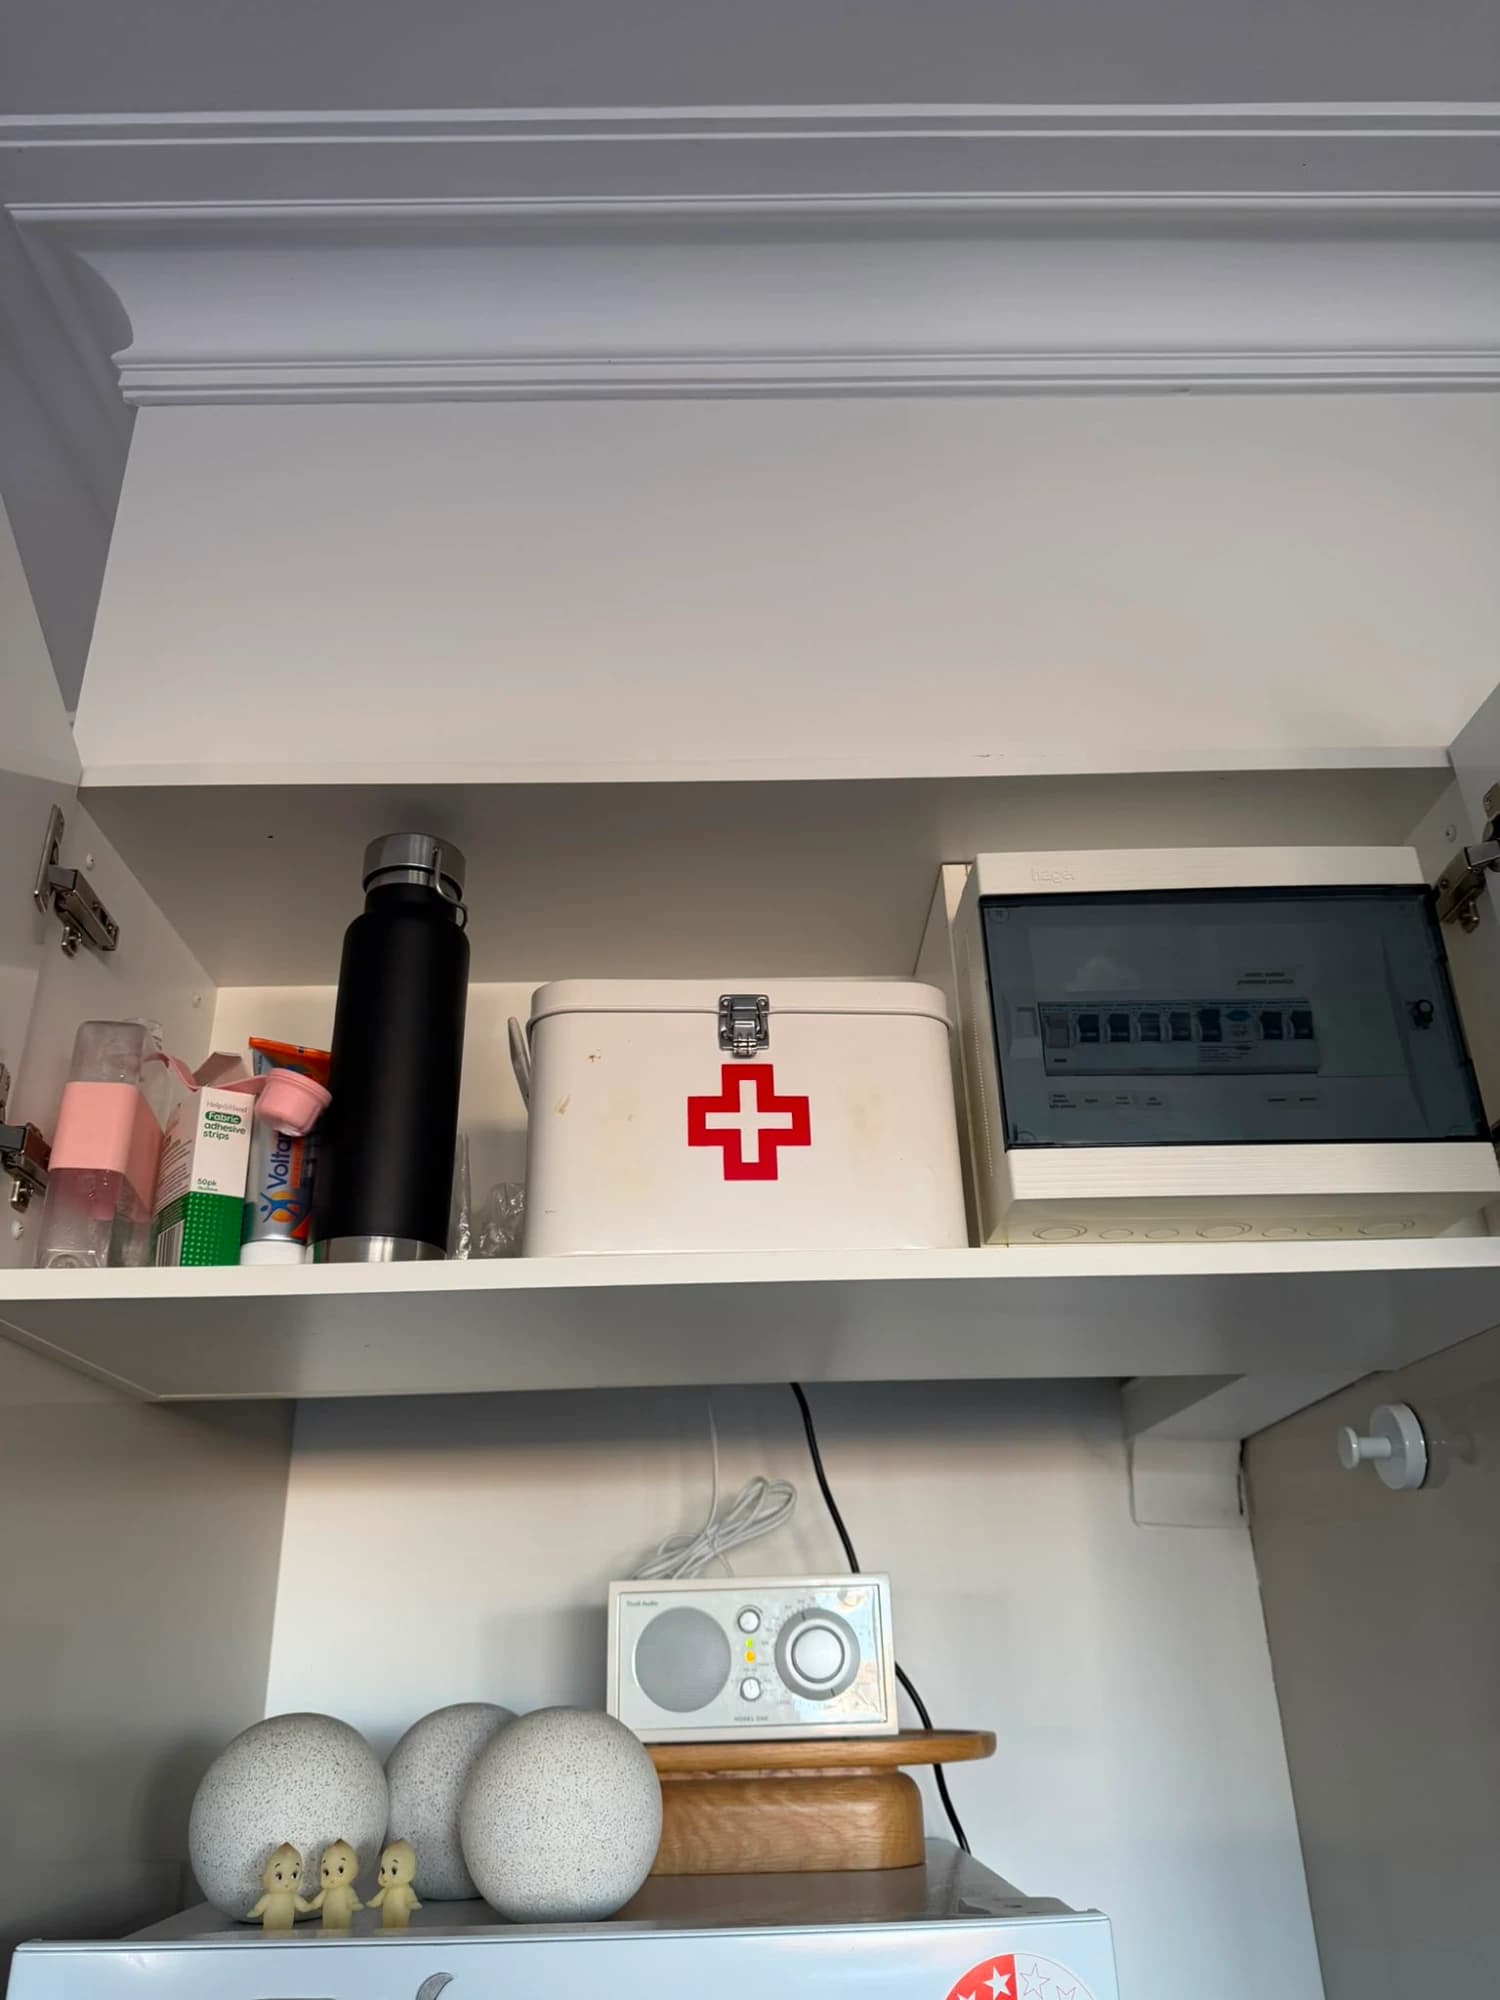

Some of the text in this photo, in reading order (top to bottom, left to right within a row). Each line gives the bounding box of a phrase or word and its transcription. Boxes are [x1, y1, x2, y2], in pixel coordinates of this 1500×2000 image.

[208, 1111, 241, 1124] Fabric
[203, 1121, 246, 1135] adhesive
[203, 1129, 230, 1141] strips
[197, 1178, 217, 1187] 50pk
